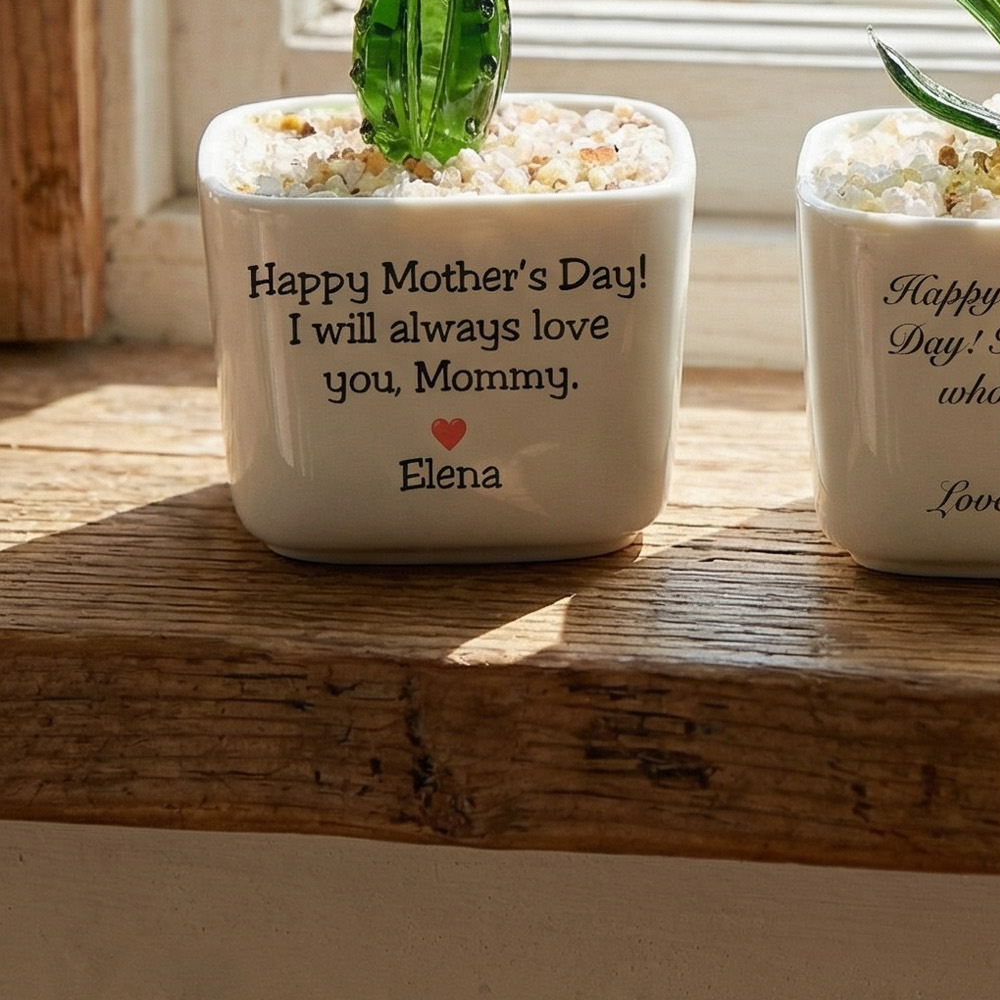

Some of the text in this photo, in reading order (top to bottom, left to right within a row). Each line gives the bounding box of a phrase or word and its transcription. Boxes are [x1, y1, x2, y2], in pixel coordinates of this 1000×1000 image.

[248, 253, 647, 305] Happy Mother's Day!
[289, 308, 610, 351] I will always love
[887, 322, 984, 366] Day!
[323, 359, 579, 404] you, Mommy.
[399, 457, 503, 491] Elena
